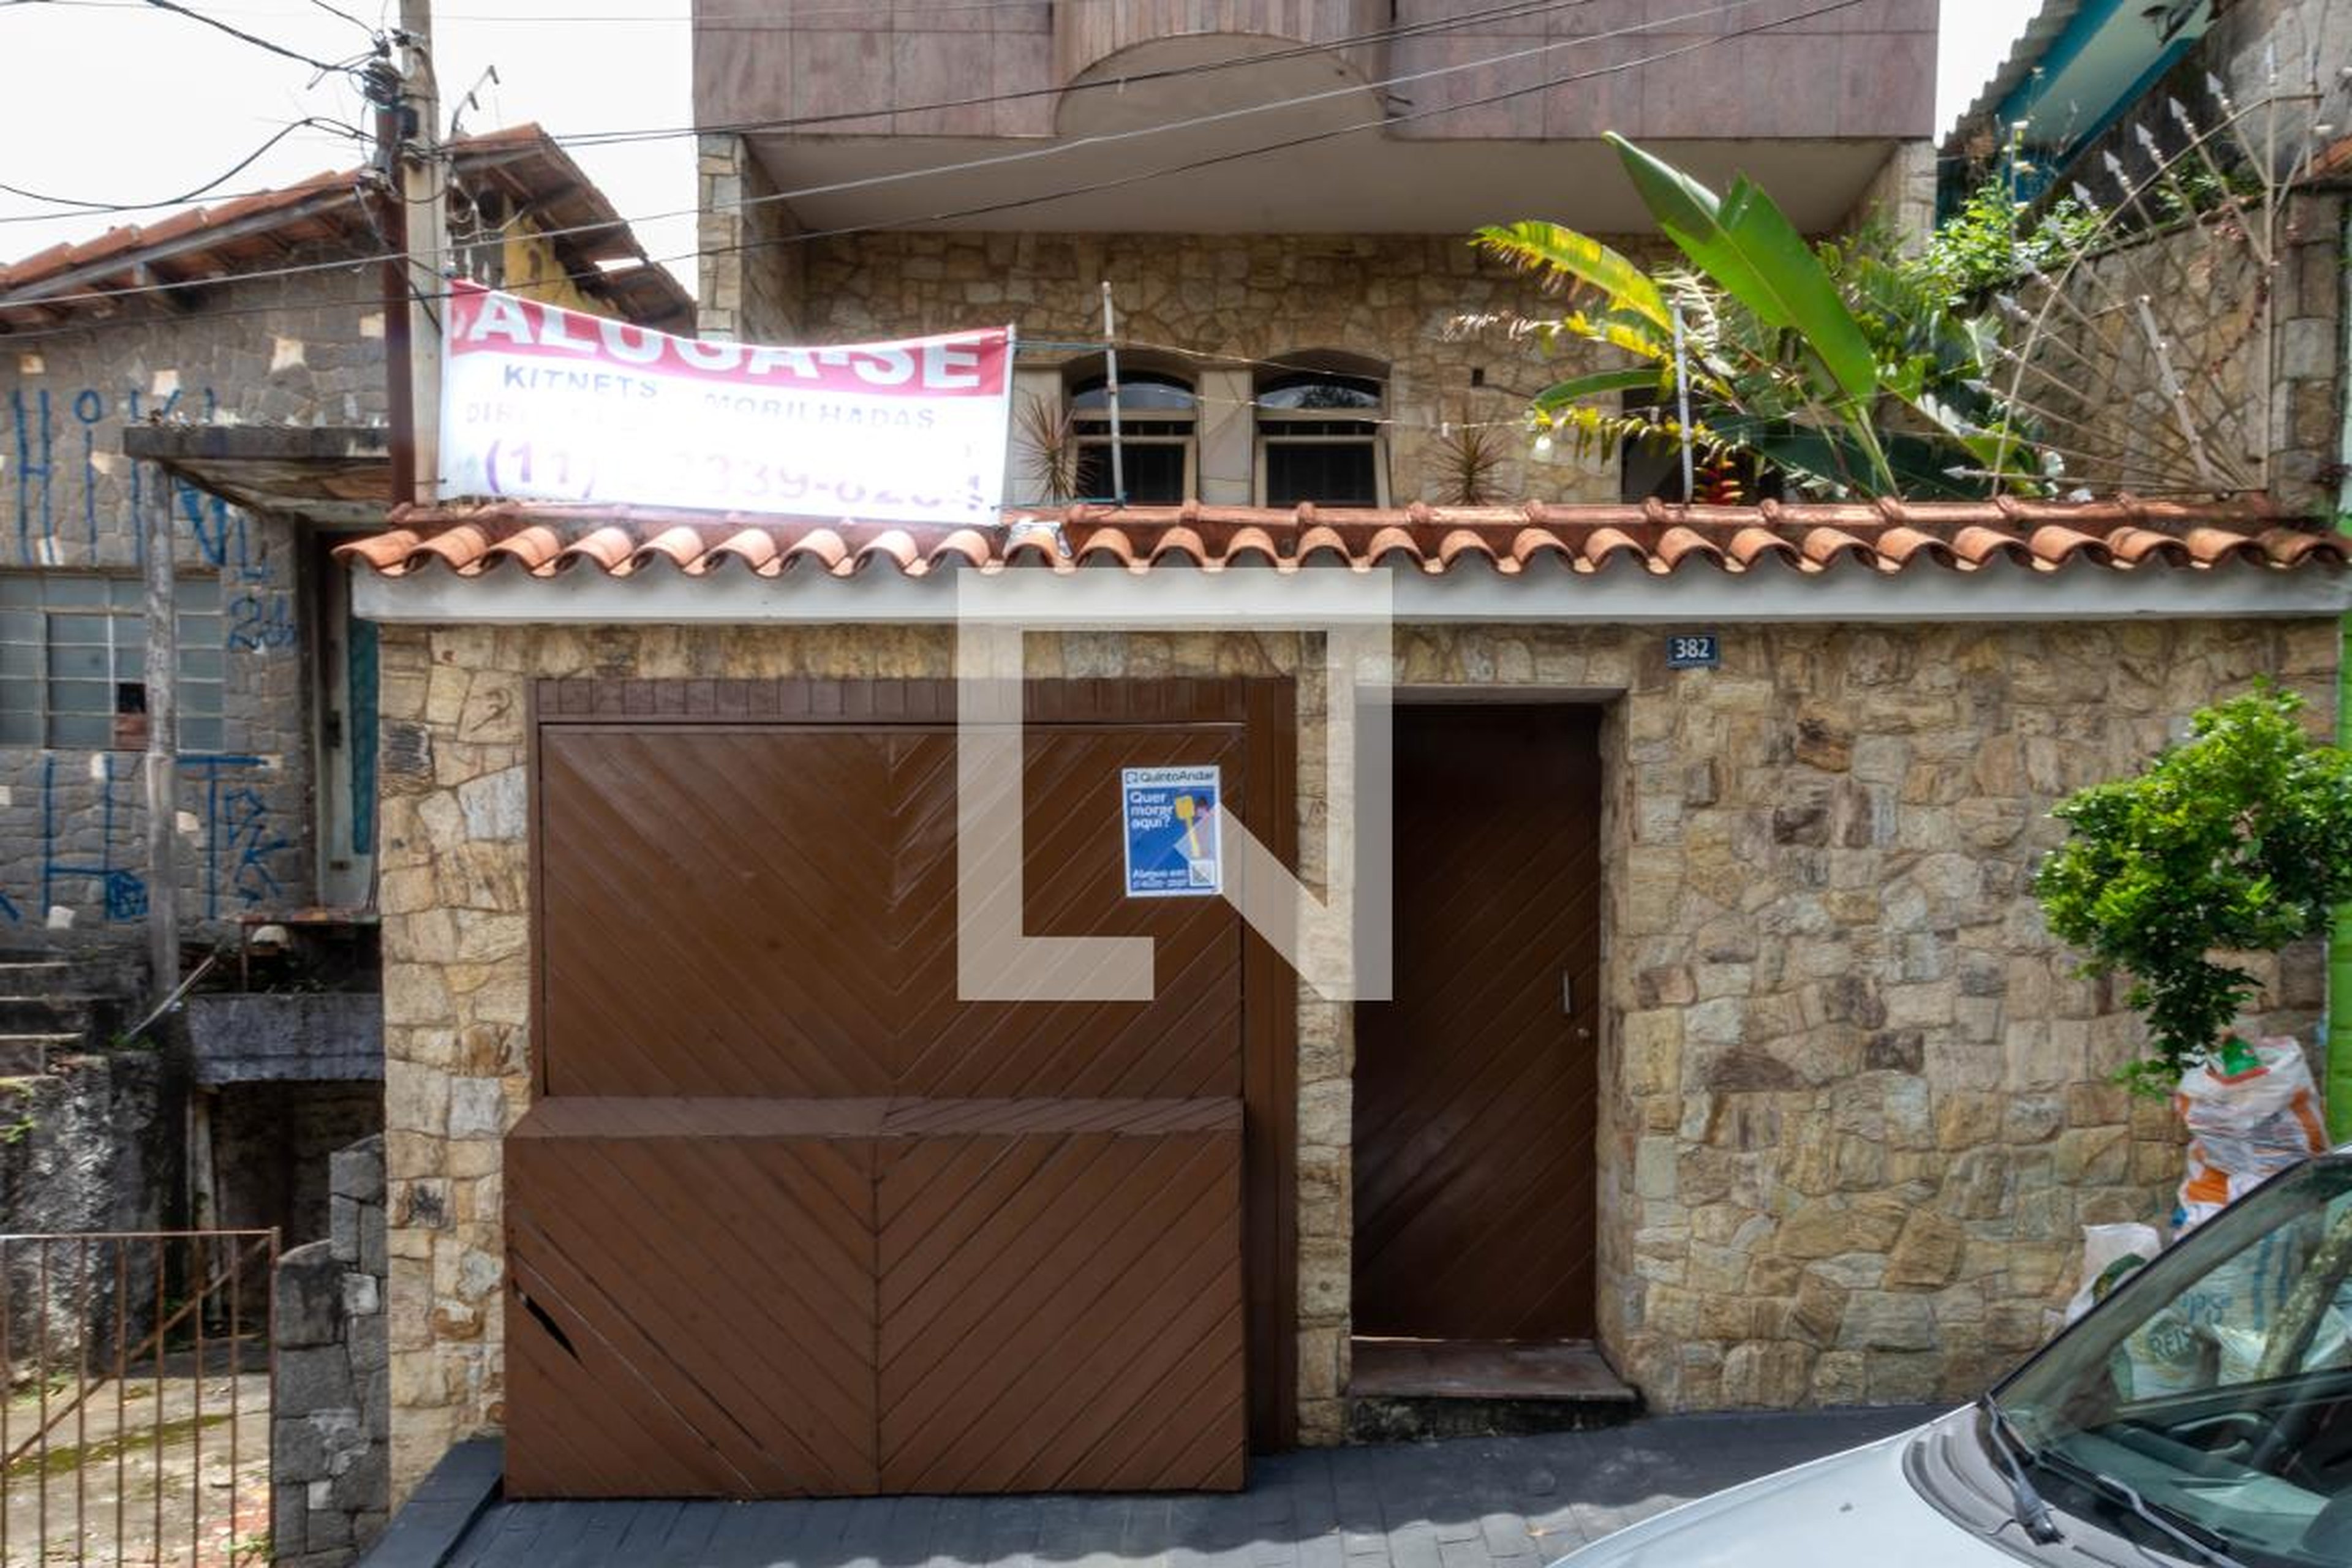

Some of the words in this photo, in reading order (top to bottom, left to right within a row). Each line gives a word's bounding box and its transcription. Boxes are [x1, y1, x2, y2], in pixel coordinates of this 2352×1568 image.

[503, 363, 658, 399] KITNETS
[1675, 638, 1709, 658] 382
[1140, 770, 1214, 782] QuintoAndar
[1130, 791, 1167, 804] Quer
[1131, 805, 1173, 816] morar
[1131, 814, 1171, 831] aqui?
